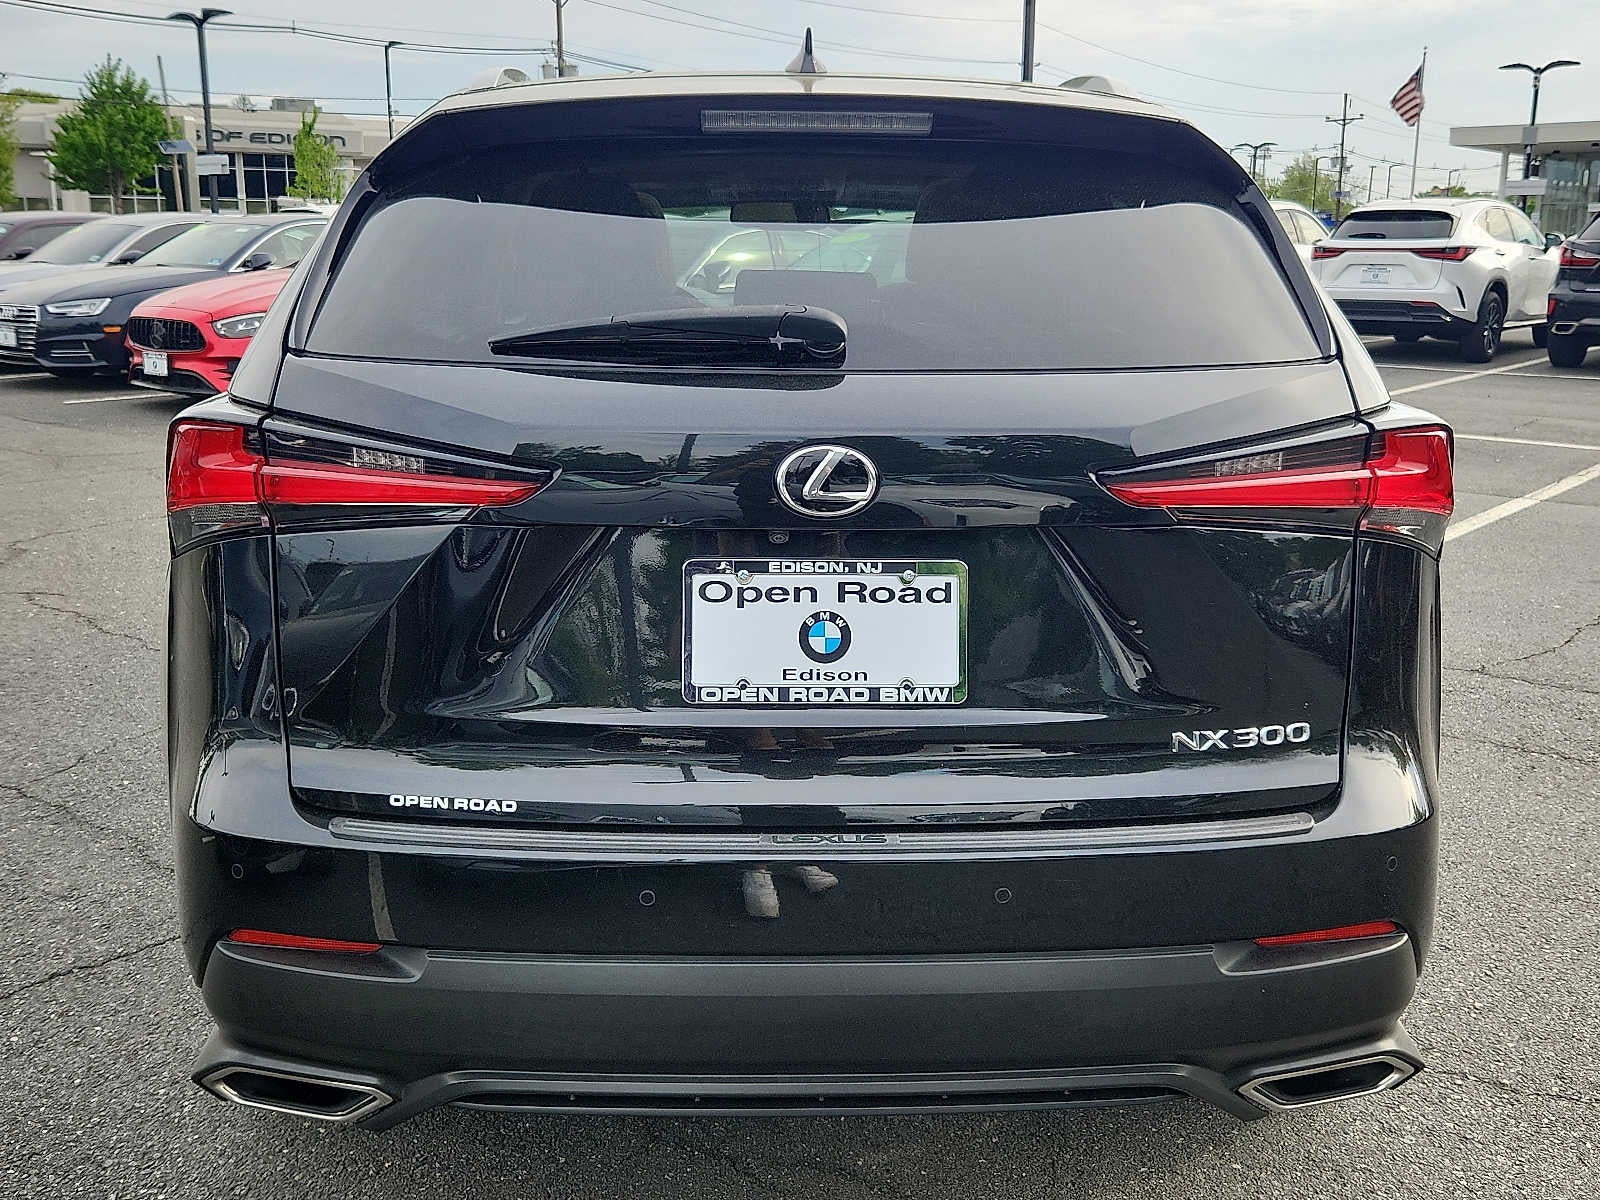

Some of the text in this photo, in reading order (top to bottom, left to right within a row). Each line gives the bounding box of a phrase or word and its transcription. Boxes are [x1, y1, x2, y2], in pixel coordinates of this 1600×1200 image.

[249, 131, 346, 147] EDION
[856, 562, 883, 574] NJ
[698, 580, 952, 608] Open Road
[805, 611, 846, 627] BMW
[782, 668, 868, 682] Edison
[701, 687, 950, 702] OPEN ROAD BMW
[389, 794, 518, 813] OPEN ROAD
[772, 834, 888, 844] LEXUS
